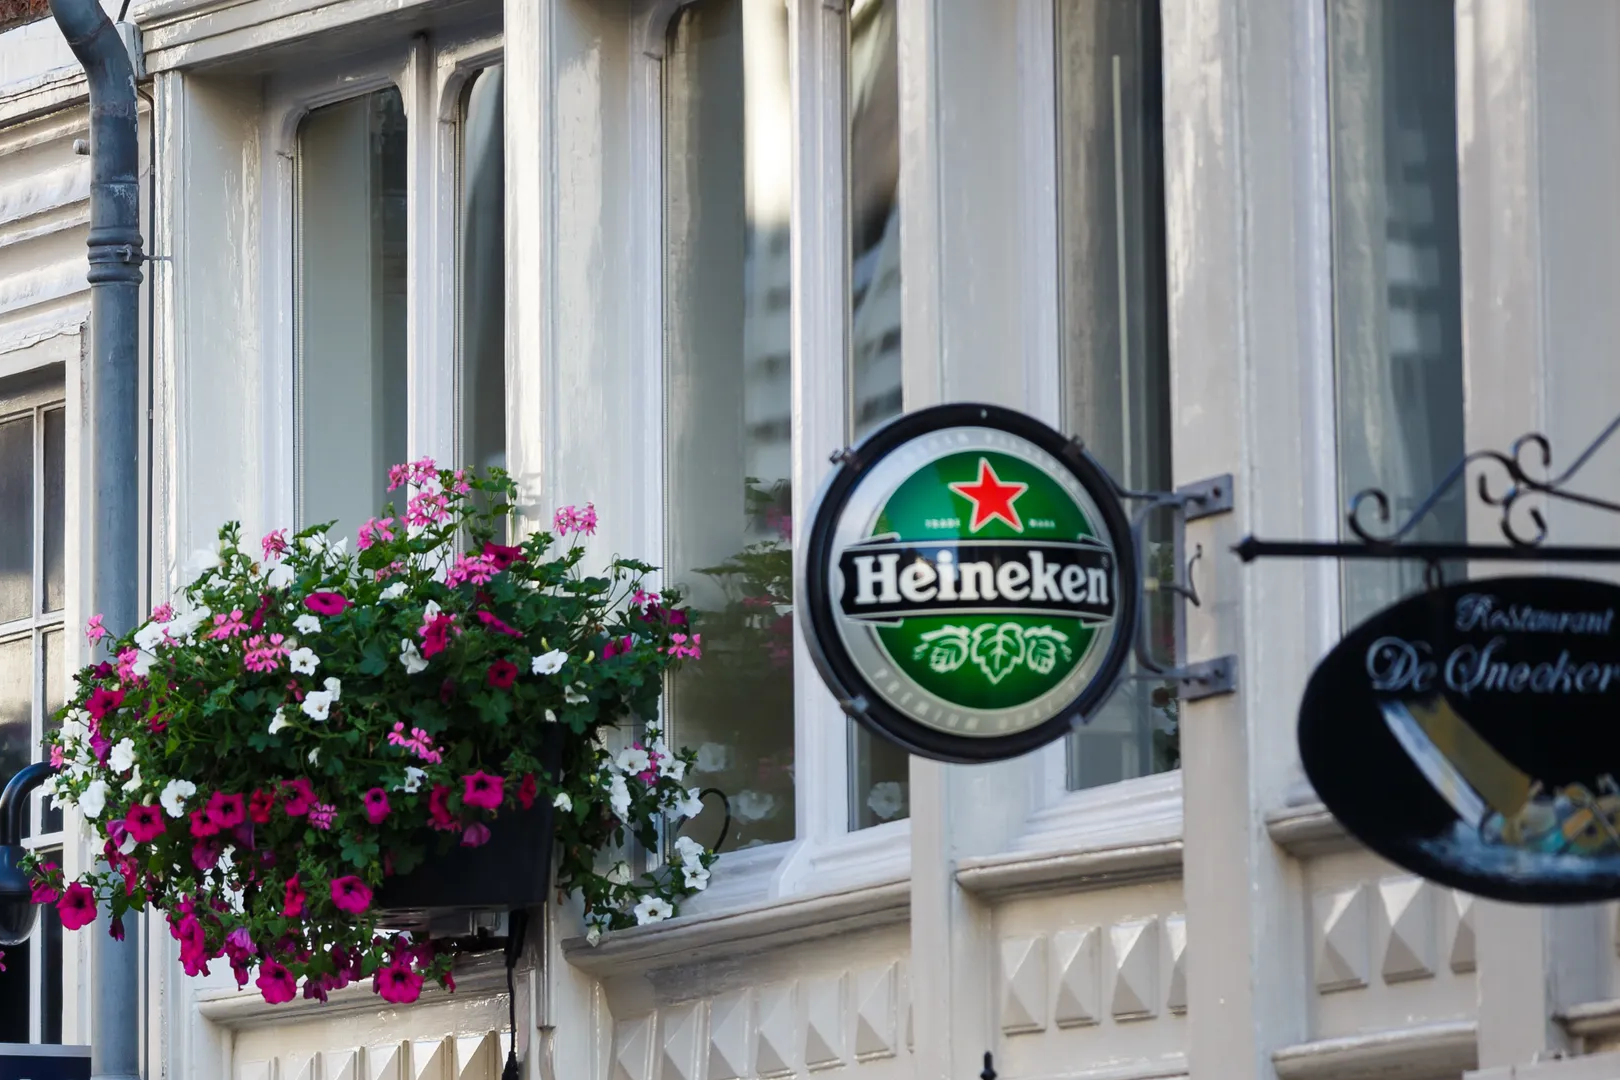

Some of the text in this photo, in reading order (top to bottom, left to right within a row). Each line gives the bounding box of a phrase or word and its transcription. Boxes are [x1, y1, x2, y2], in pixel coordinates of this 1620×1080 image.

[853, 549, 1109, 605] Heineken
[1455, 593, 1614, 634] Restaurant
[1366, 636, 1437, 691] De
